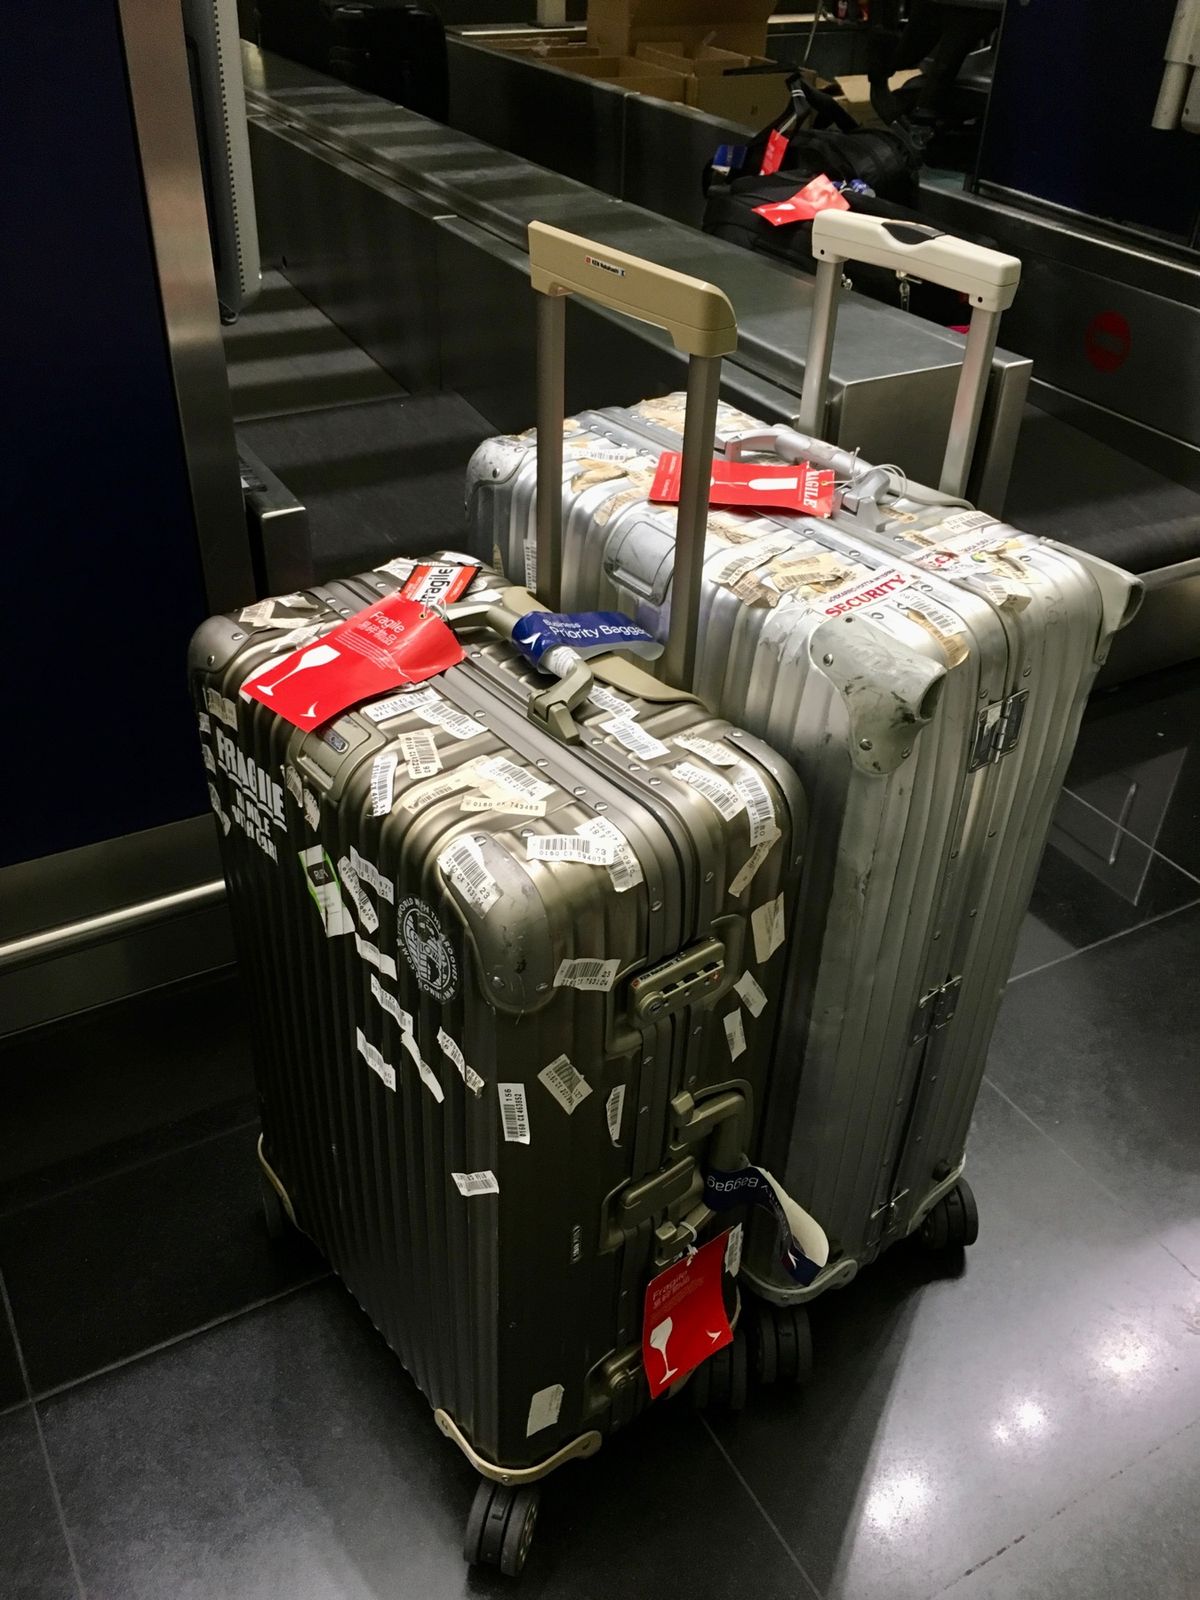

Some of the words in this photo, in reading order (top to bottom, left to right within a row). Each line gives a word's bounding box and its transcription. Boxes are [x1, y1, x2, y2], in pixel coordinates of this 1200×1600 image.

[803, 460, 820, 508] AGILE
[825, 573, 907, 618] SECURITY
[371, 611, 405, 634] Fragile
[549, 625, 600, 639] Priority
[478, 885, 490, 900] 23
[503, 1088, 512, 1101] 156
[706, 1175, 759, 1192] Baggag
